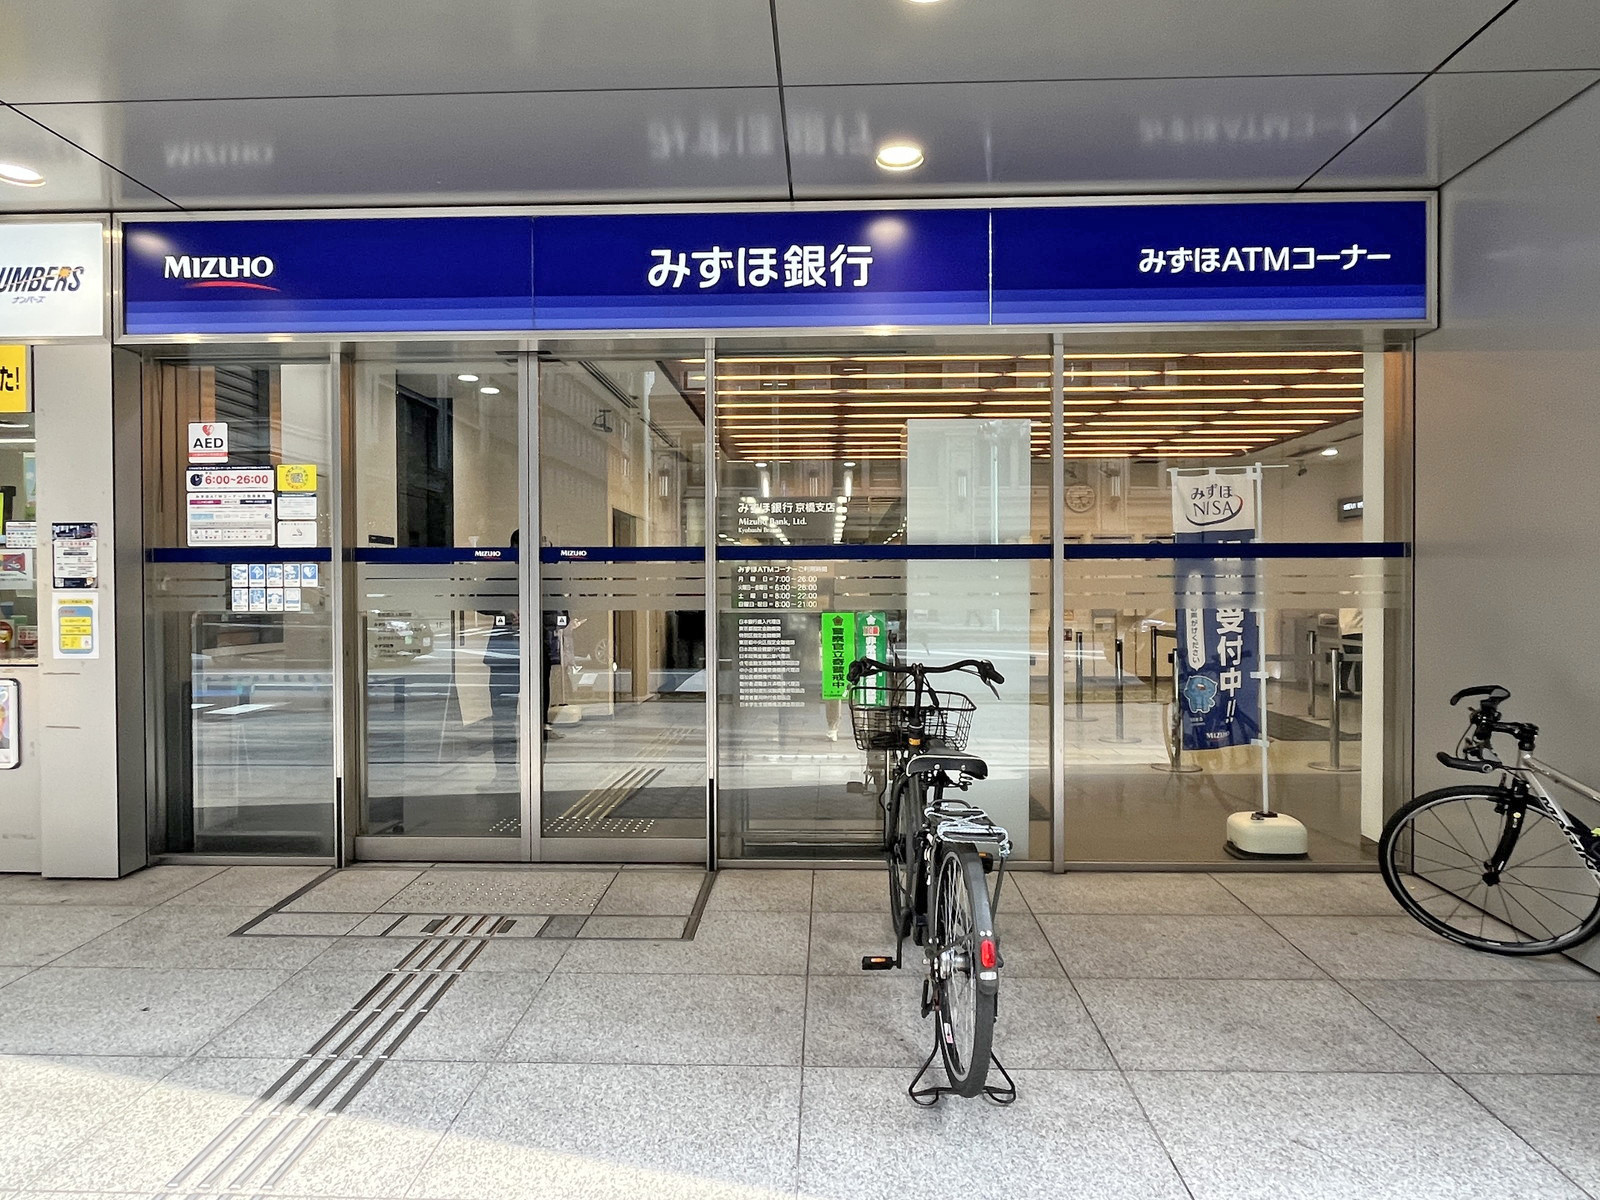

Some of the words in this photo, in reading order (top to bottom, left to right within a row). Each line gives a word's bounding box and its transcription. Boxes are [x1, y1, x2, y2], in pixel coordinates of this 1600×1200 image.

[164, 256, 274, 278] MIZUHO
[648, 244, 873, 288] みずほ銀行
[1139, 244, 1391, 273] みずほATMコーナー
[193, 437, 224, 449] AED
[1191, 483, 1233, 500] みずほ
[795, 502, 836, 514] 京橋支店
[1193, 500, 1234, 517] NISA
[738, 518, 768, 526] Mizuho
[793, 518, 808, 526] Ltd.
